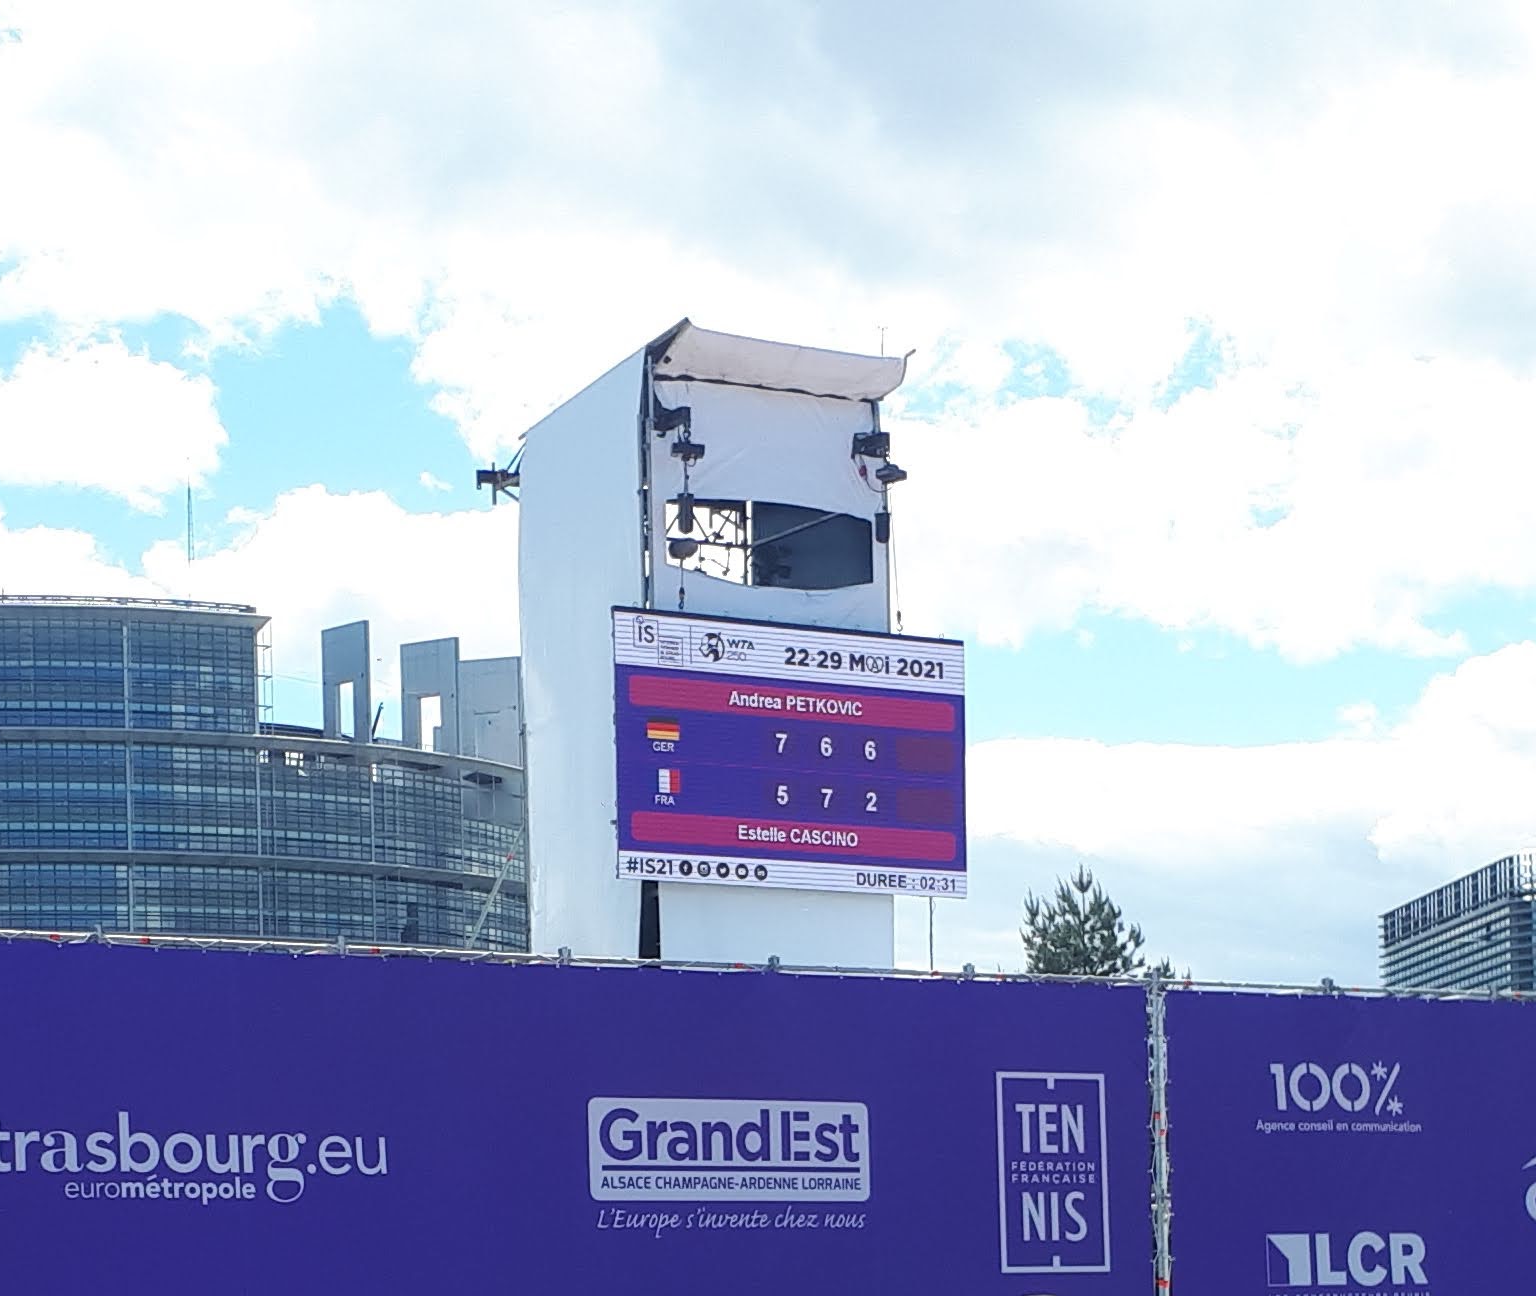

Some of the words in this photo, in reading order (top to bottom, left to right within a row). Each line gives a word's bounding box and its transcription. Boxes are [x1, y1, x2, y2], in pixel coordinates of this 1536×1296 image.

[727, 638, 755, 650] WTA
[897, 657, 944, 680] 2021
[728, 690, 782, 712] Andrea
[786, 695, 863, 717] PETKOVIC
[652, 741, 675, 753] GER
[775, 732, 788, 754] 7
[820, 736, 833, 757] 6
[864, 740, 877, 761] 6
[654, 794, 676, 806] FRA
[776, 785, 789, 805] 5
[821, 788, 833, 808] 7
[866, 792, 877, 812] 2
[737, 824, 786, 842] Estelle
[790, 828, 859, 848] CASCINO
[626, 856, 673, 876] #IS21
[856, 872, 907, 889] DUREE
[920, 876, 956, 893] 02:31
[1015, 1103, 1086, 1155] TEN
[1255, 1119, 1296, 1134] Agence
[1298, 1119, 1334, 1131] conseil
[1336, 1122, 1349, 1131] en
[1351, 1120, 1422, 1133] communication
[1011, 1159, 1096, 1173] FÉDÉRATION
[64, 1174, 256, 1206] eurométropole
[600, 1175, 652, 1190] ALSACE
[654, 1175, 799, 1192] CHAMPAGNE-ARDENNE
[802, 1176, 862, 1192] LORRAINE
[1010, 1172, 1096, 1186] FRANÇAISE
[596, 1208, 682, 1239] L'Europe
[774, 1206, 820, 1229] chez
[823, 1210, 866, 1229] nous
[1022, 1190, 1089, 1242] NIS
[1315, 1231, 1429, 1287] LCR
